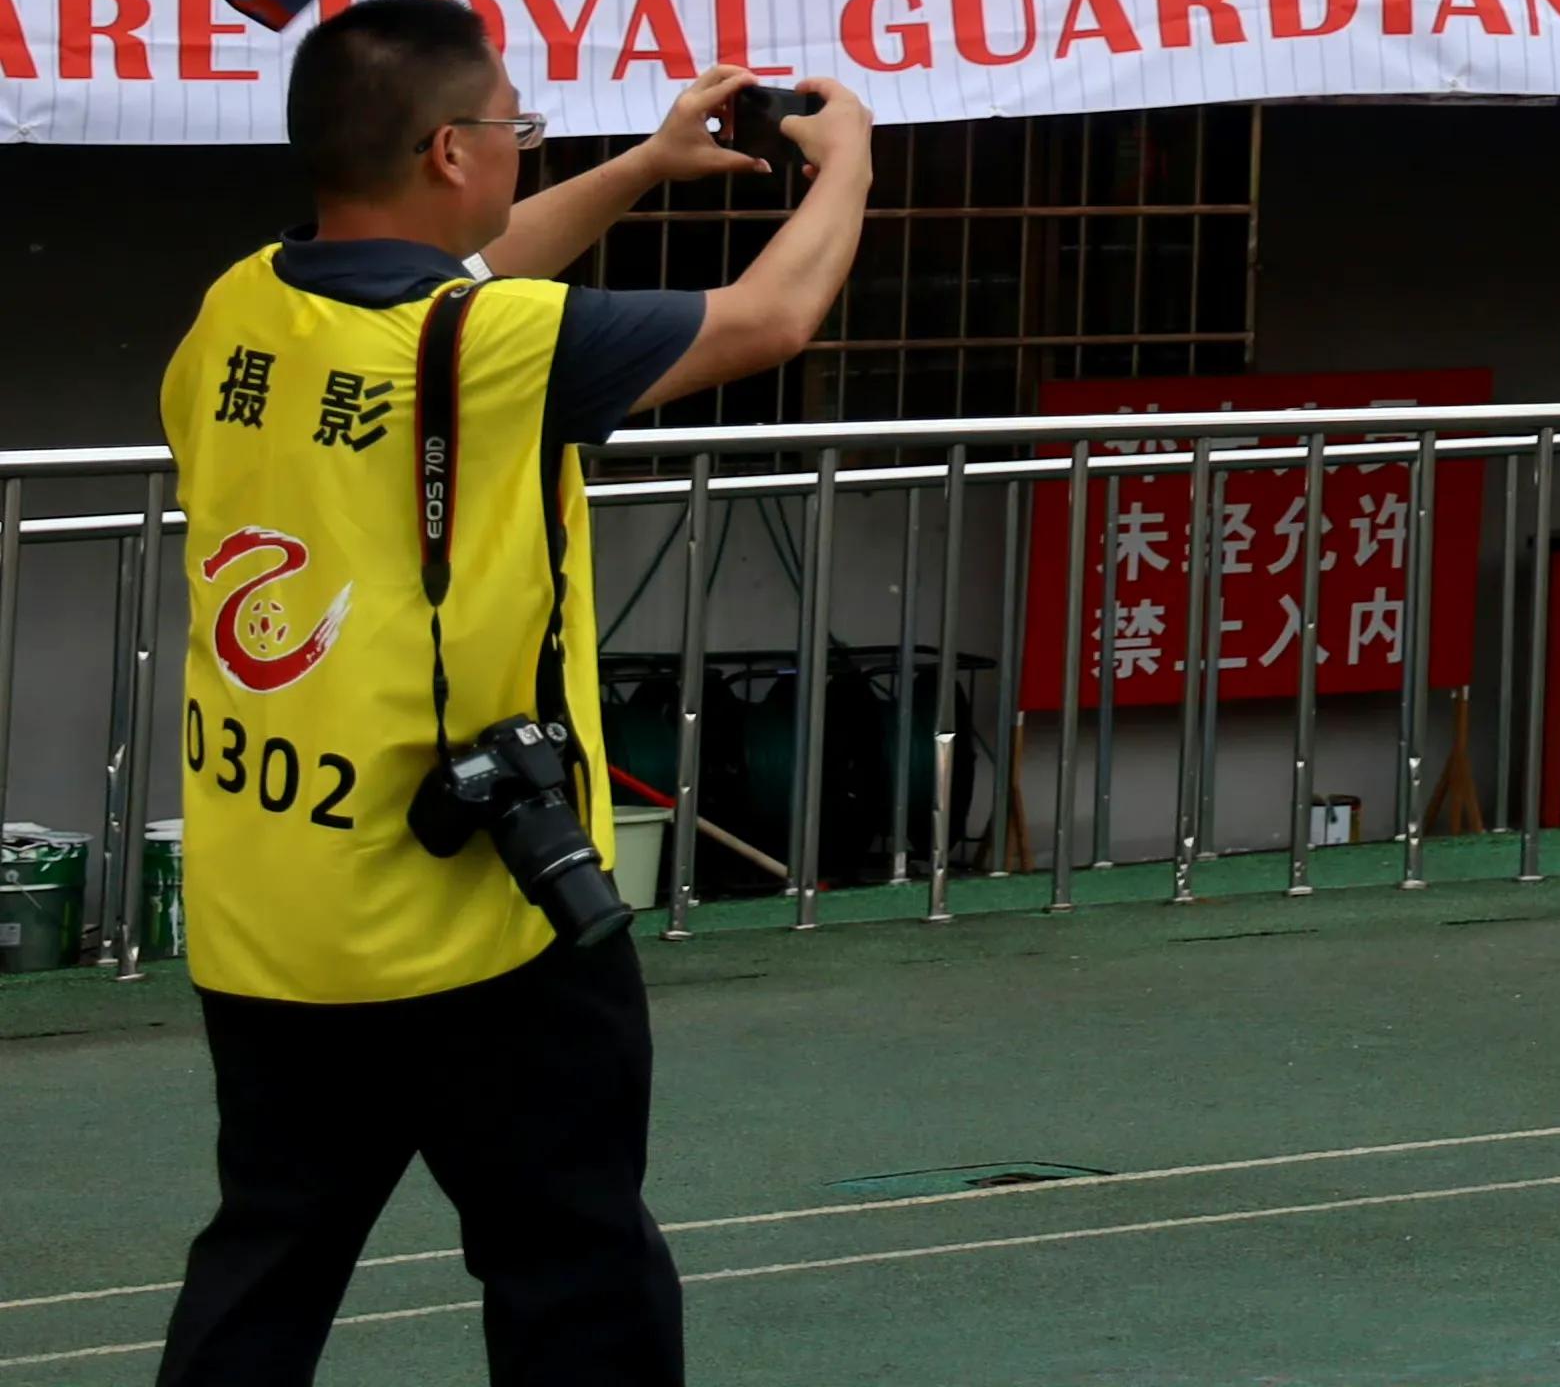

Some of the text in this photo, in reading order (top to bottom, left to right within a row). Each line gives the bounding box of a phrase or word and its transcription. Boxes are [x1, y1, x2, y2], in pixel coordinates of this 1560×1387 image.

[214, 344, 397, 454] 摄影
[424, 435, 446, 539] EOS 70D
[187, 698, 358, 832] 0302
